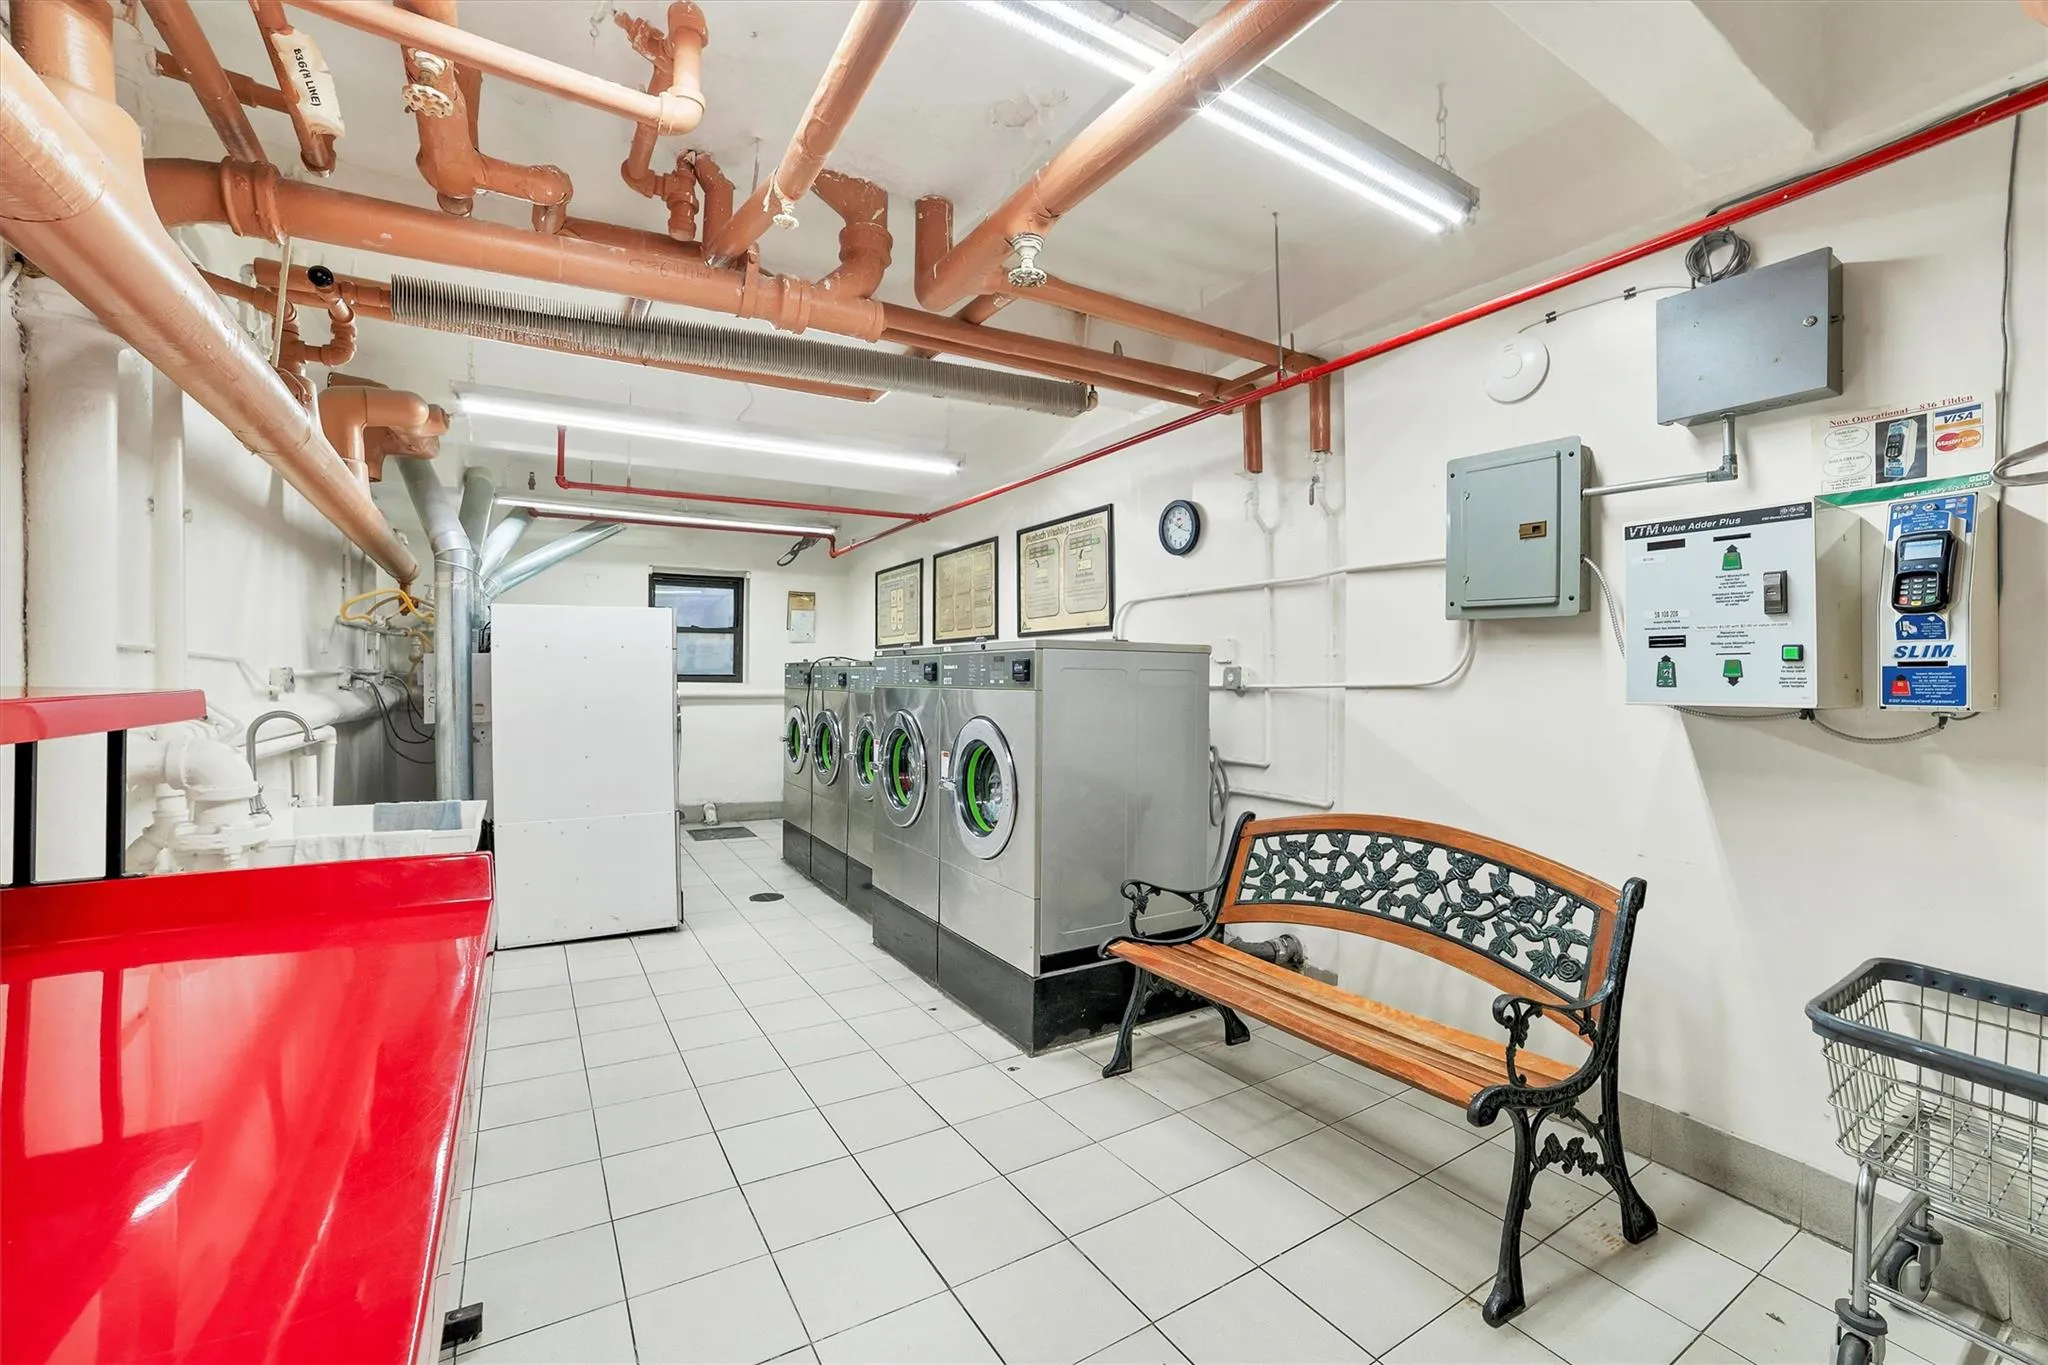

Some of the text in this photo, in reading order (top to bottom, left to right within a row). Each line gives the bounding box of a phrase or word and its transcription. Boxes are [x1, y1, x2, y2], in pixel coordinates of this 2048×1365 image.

[305, 81, 322, 107] LINE)
[1829, 419, 1848, 427] Now
[1942, 394, 1974, 406] Tilden
[1943, 411, 1973, 424] VISA
[1936, 433, 1981, 448] MasterCard
[1916, 487, 1946, 497] Laundry
[1628, 516, 1741, 538] VTM Value Adder Plus
[1894, 644, 1954, 658] SLIM
